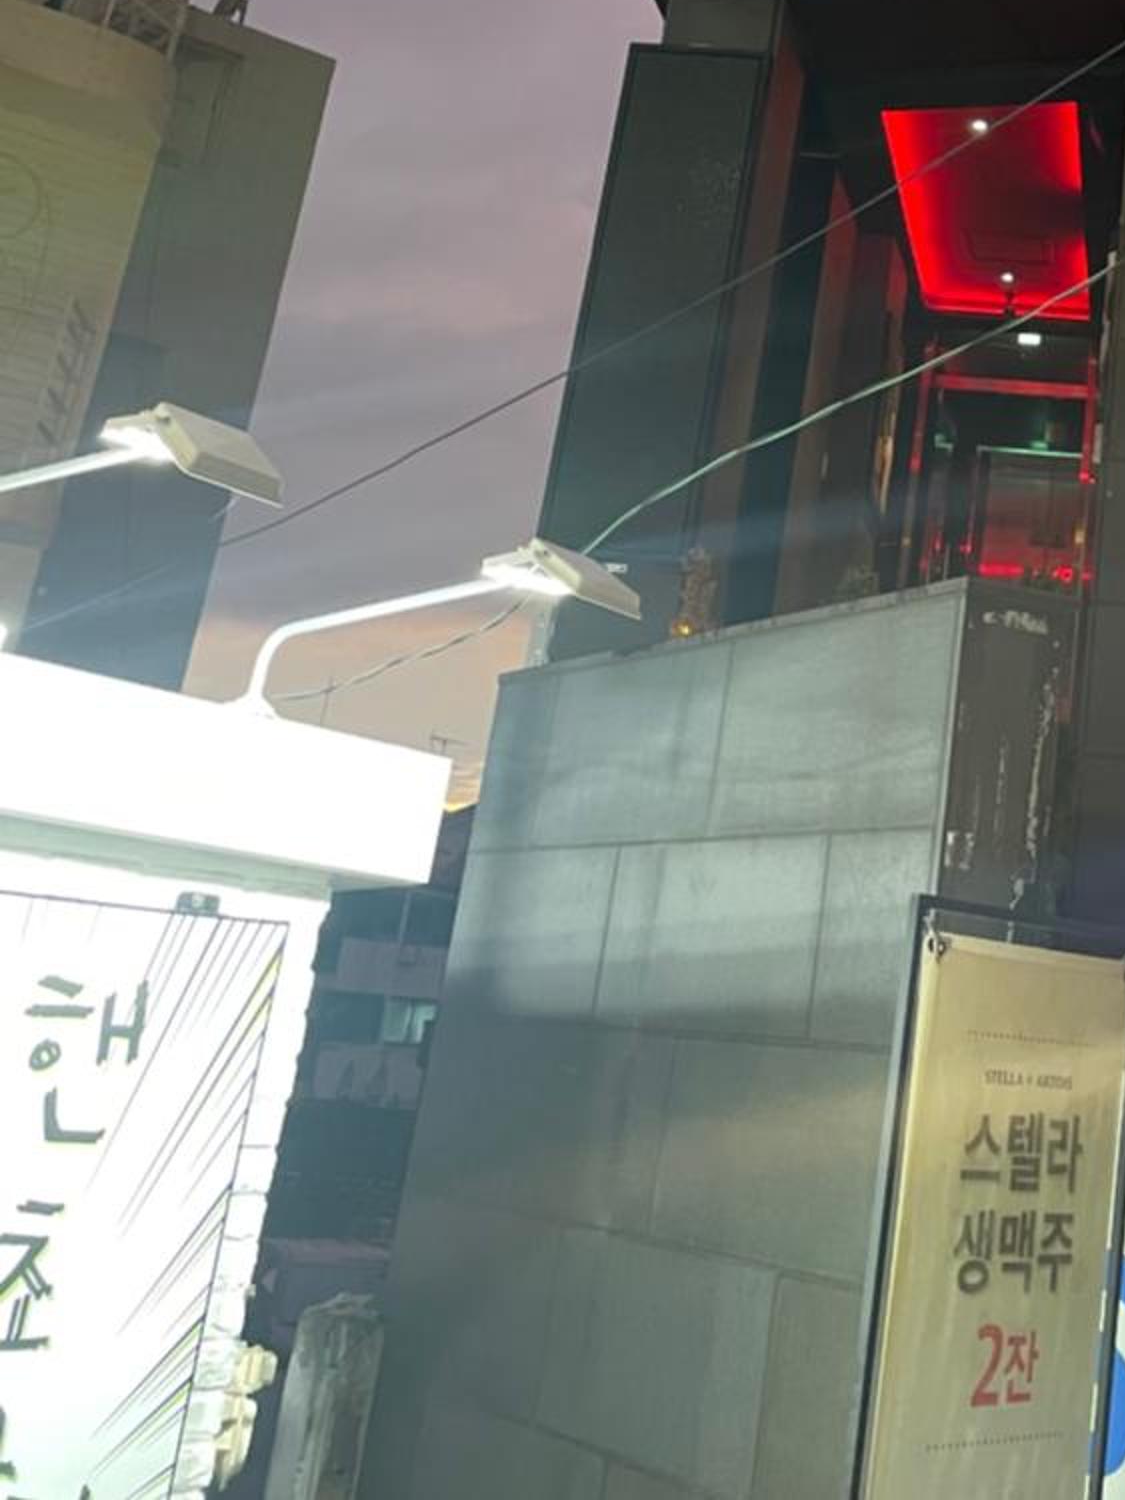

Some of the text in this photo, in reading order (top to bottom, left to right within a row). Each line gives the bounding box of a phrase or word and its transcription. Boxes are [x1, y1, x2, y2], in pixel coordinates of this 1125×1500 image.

[960, 1113, 1082, 1194] 스텔라
[954, 1209, 1074, 1294] 생맥주
[970, 1324, 1039, 1408] 2잔
